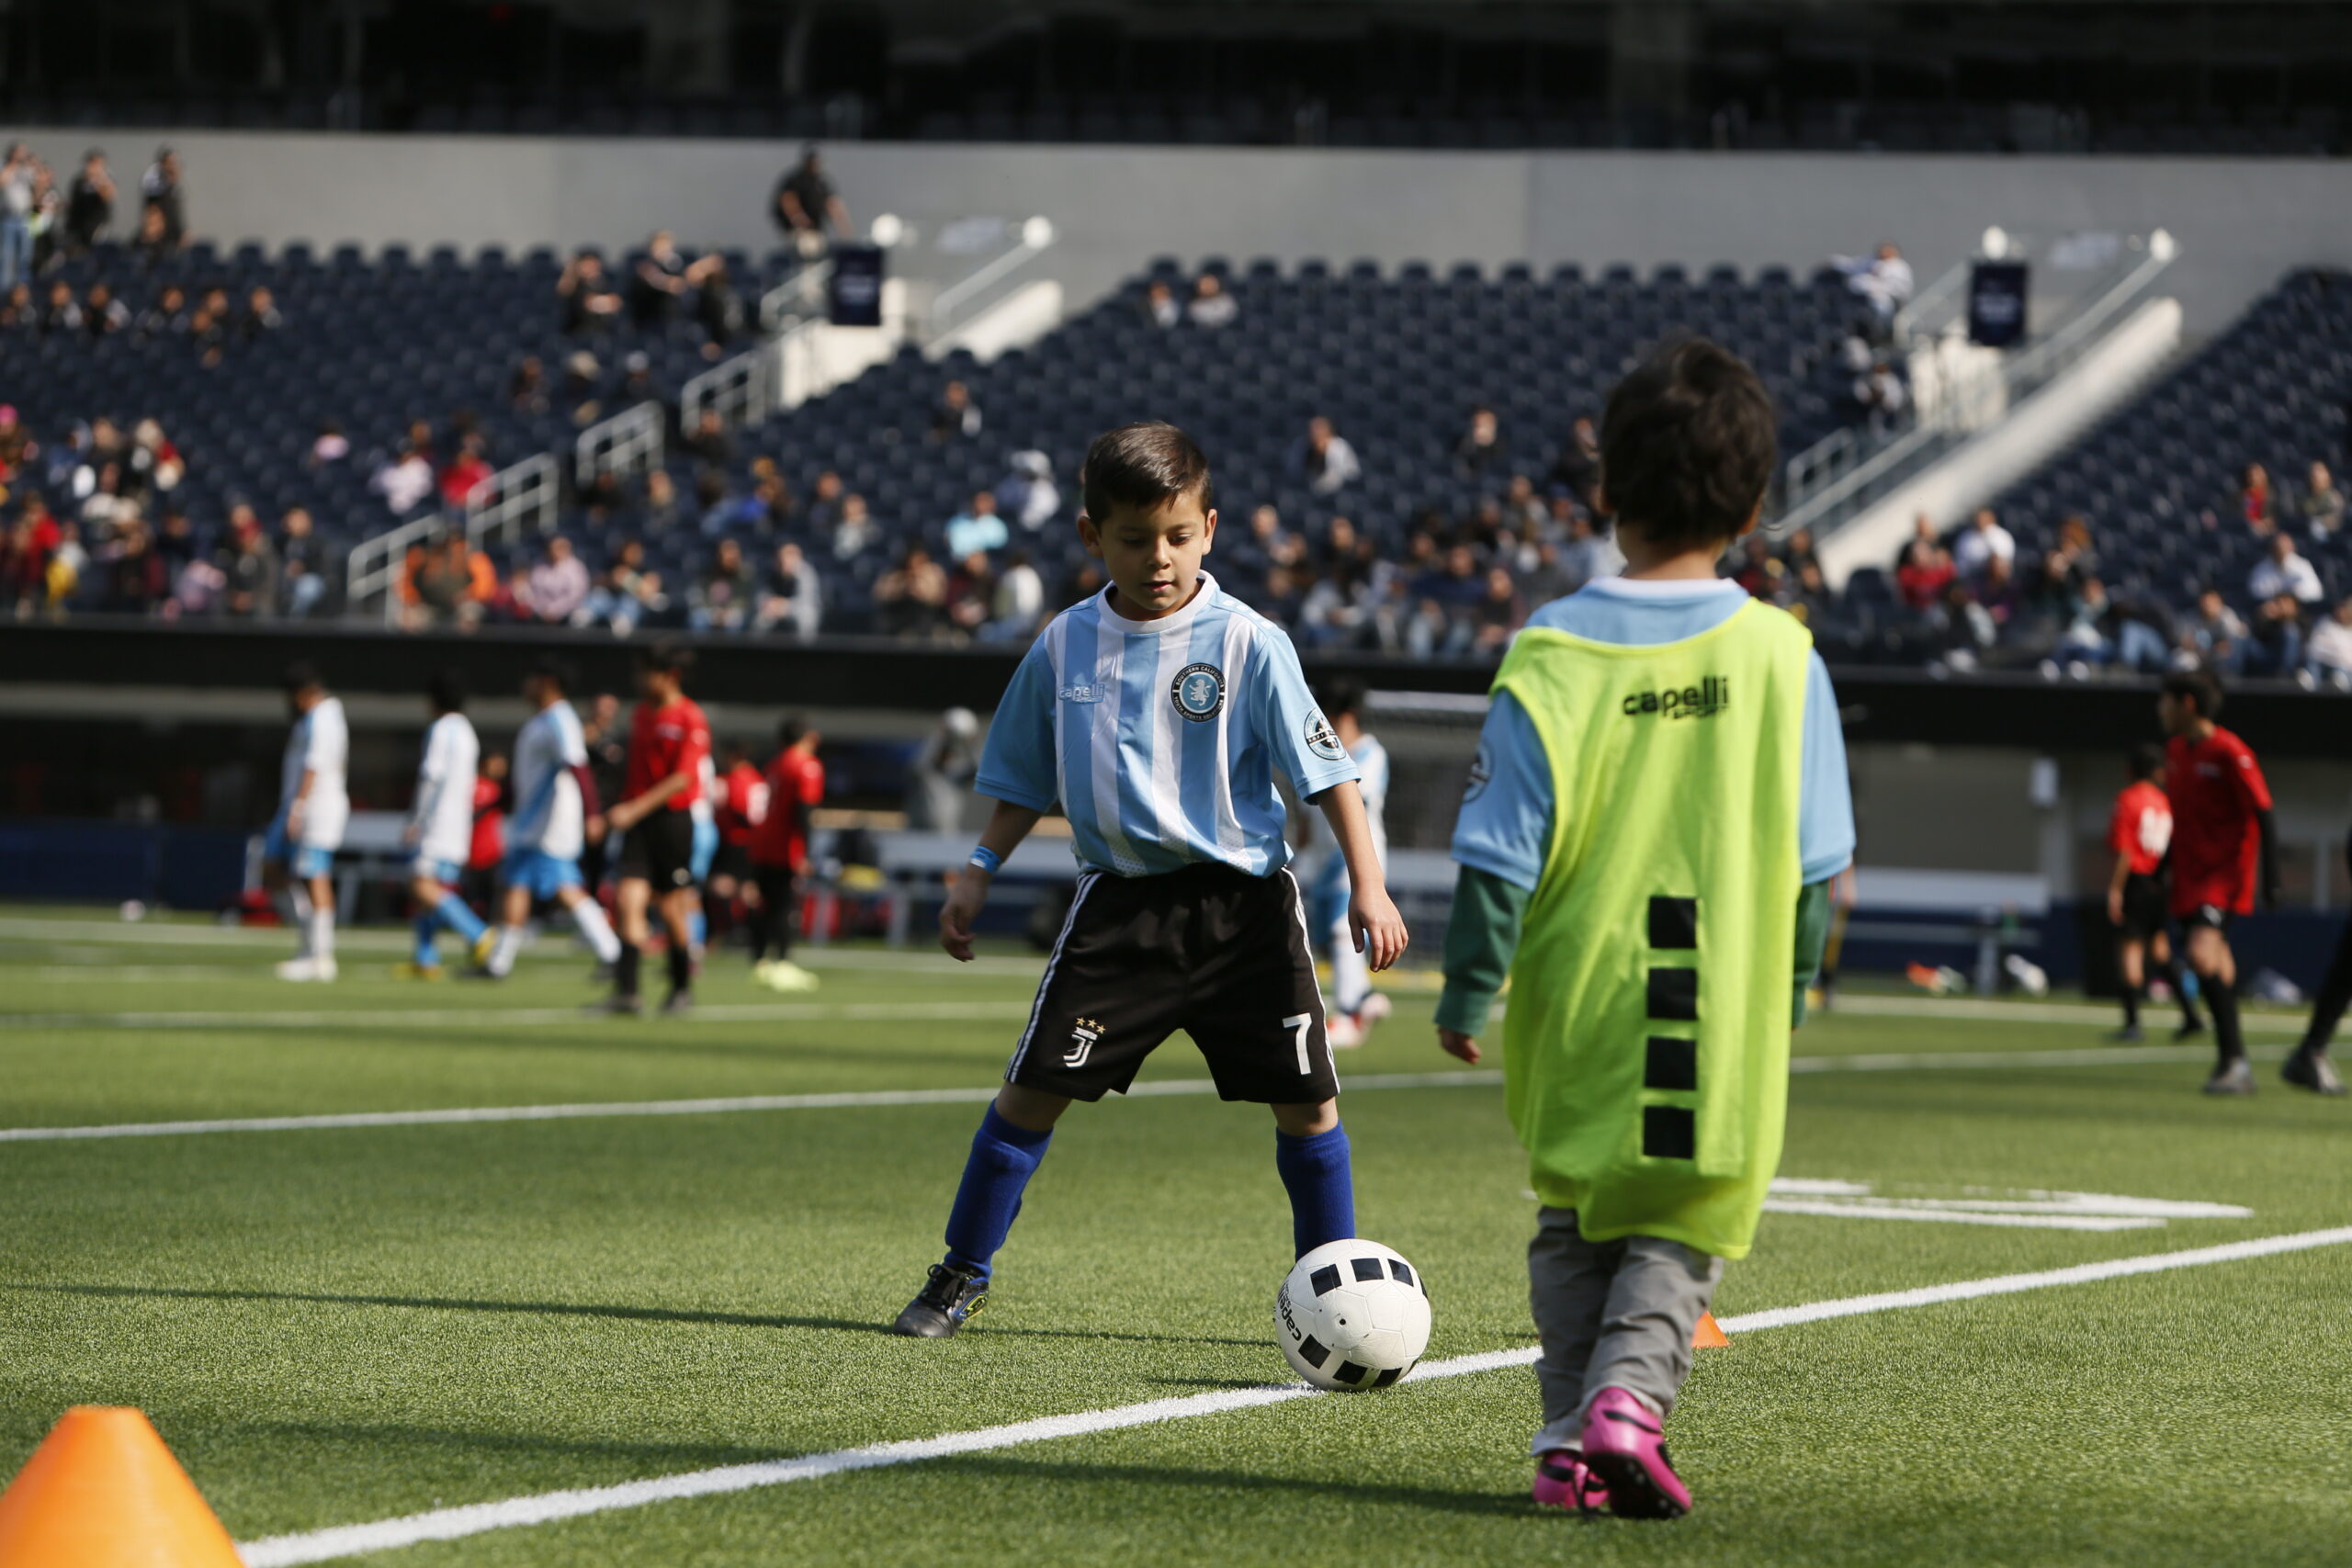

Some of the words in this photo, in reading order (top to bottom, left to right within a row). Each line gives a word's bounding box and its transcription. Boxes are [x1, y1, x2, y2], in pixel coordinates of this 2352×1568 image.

[1058, 683, 1103, 701] capelli
[1623, 676, 1728, 716] capelli
[1283, 1012, 1313, 1076] 7
